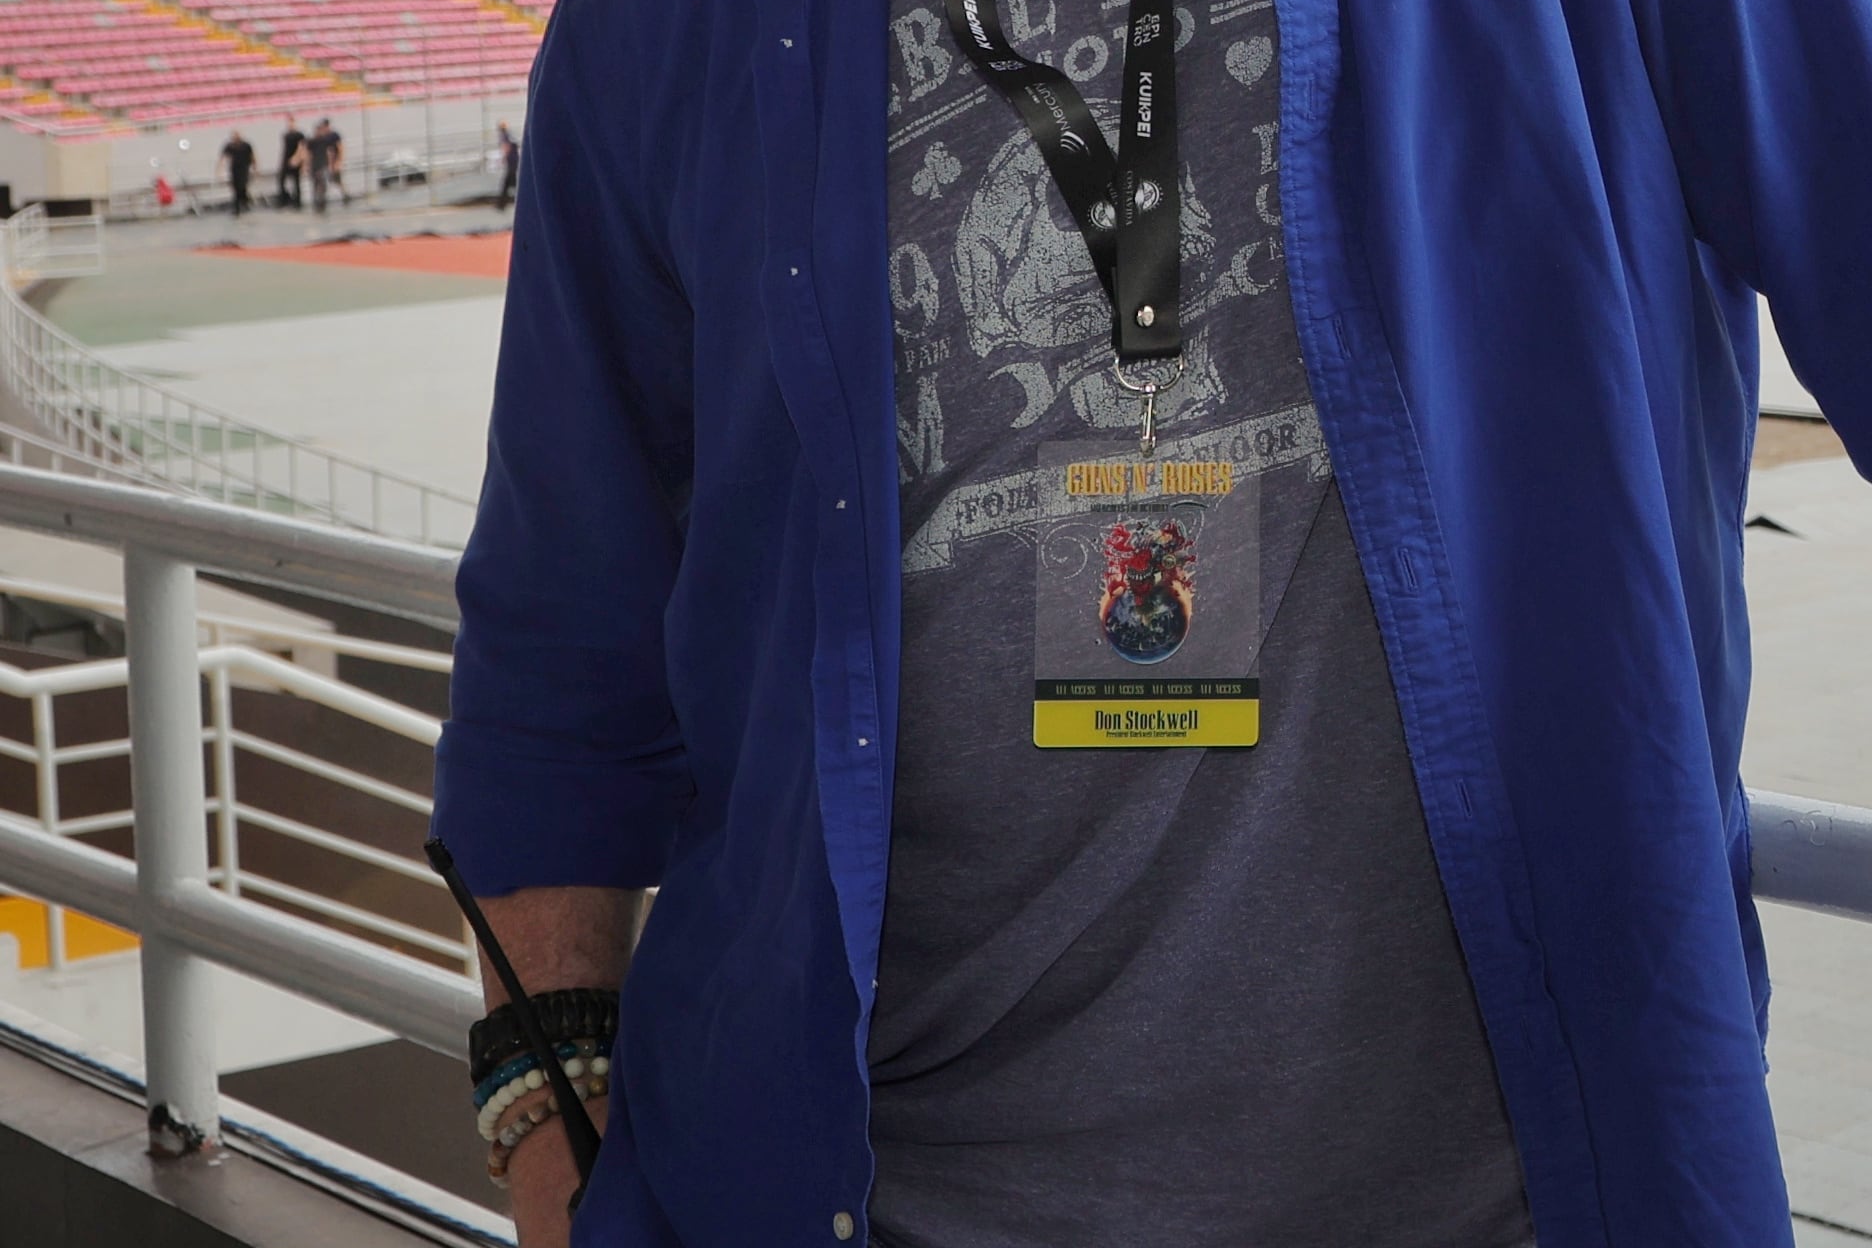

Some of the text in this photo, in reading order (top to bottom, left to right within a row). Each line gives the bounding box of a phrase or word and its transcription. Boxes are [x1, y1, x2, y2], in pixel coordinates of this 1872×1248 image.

[1032, 82, 1071, 131] Mercury
[1136, 71, 1153, 138] KUIKPEI
[1067, 463, 1127, 495] GUNS
[1161, 461, 1233, 495] ROSES
[1095, 709, 1198, 730] Don Stockwell
